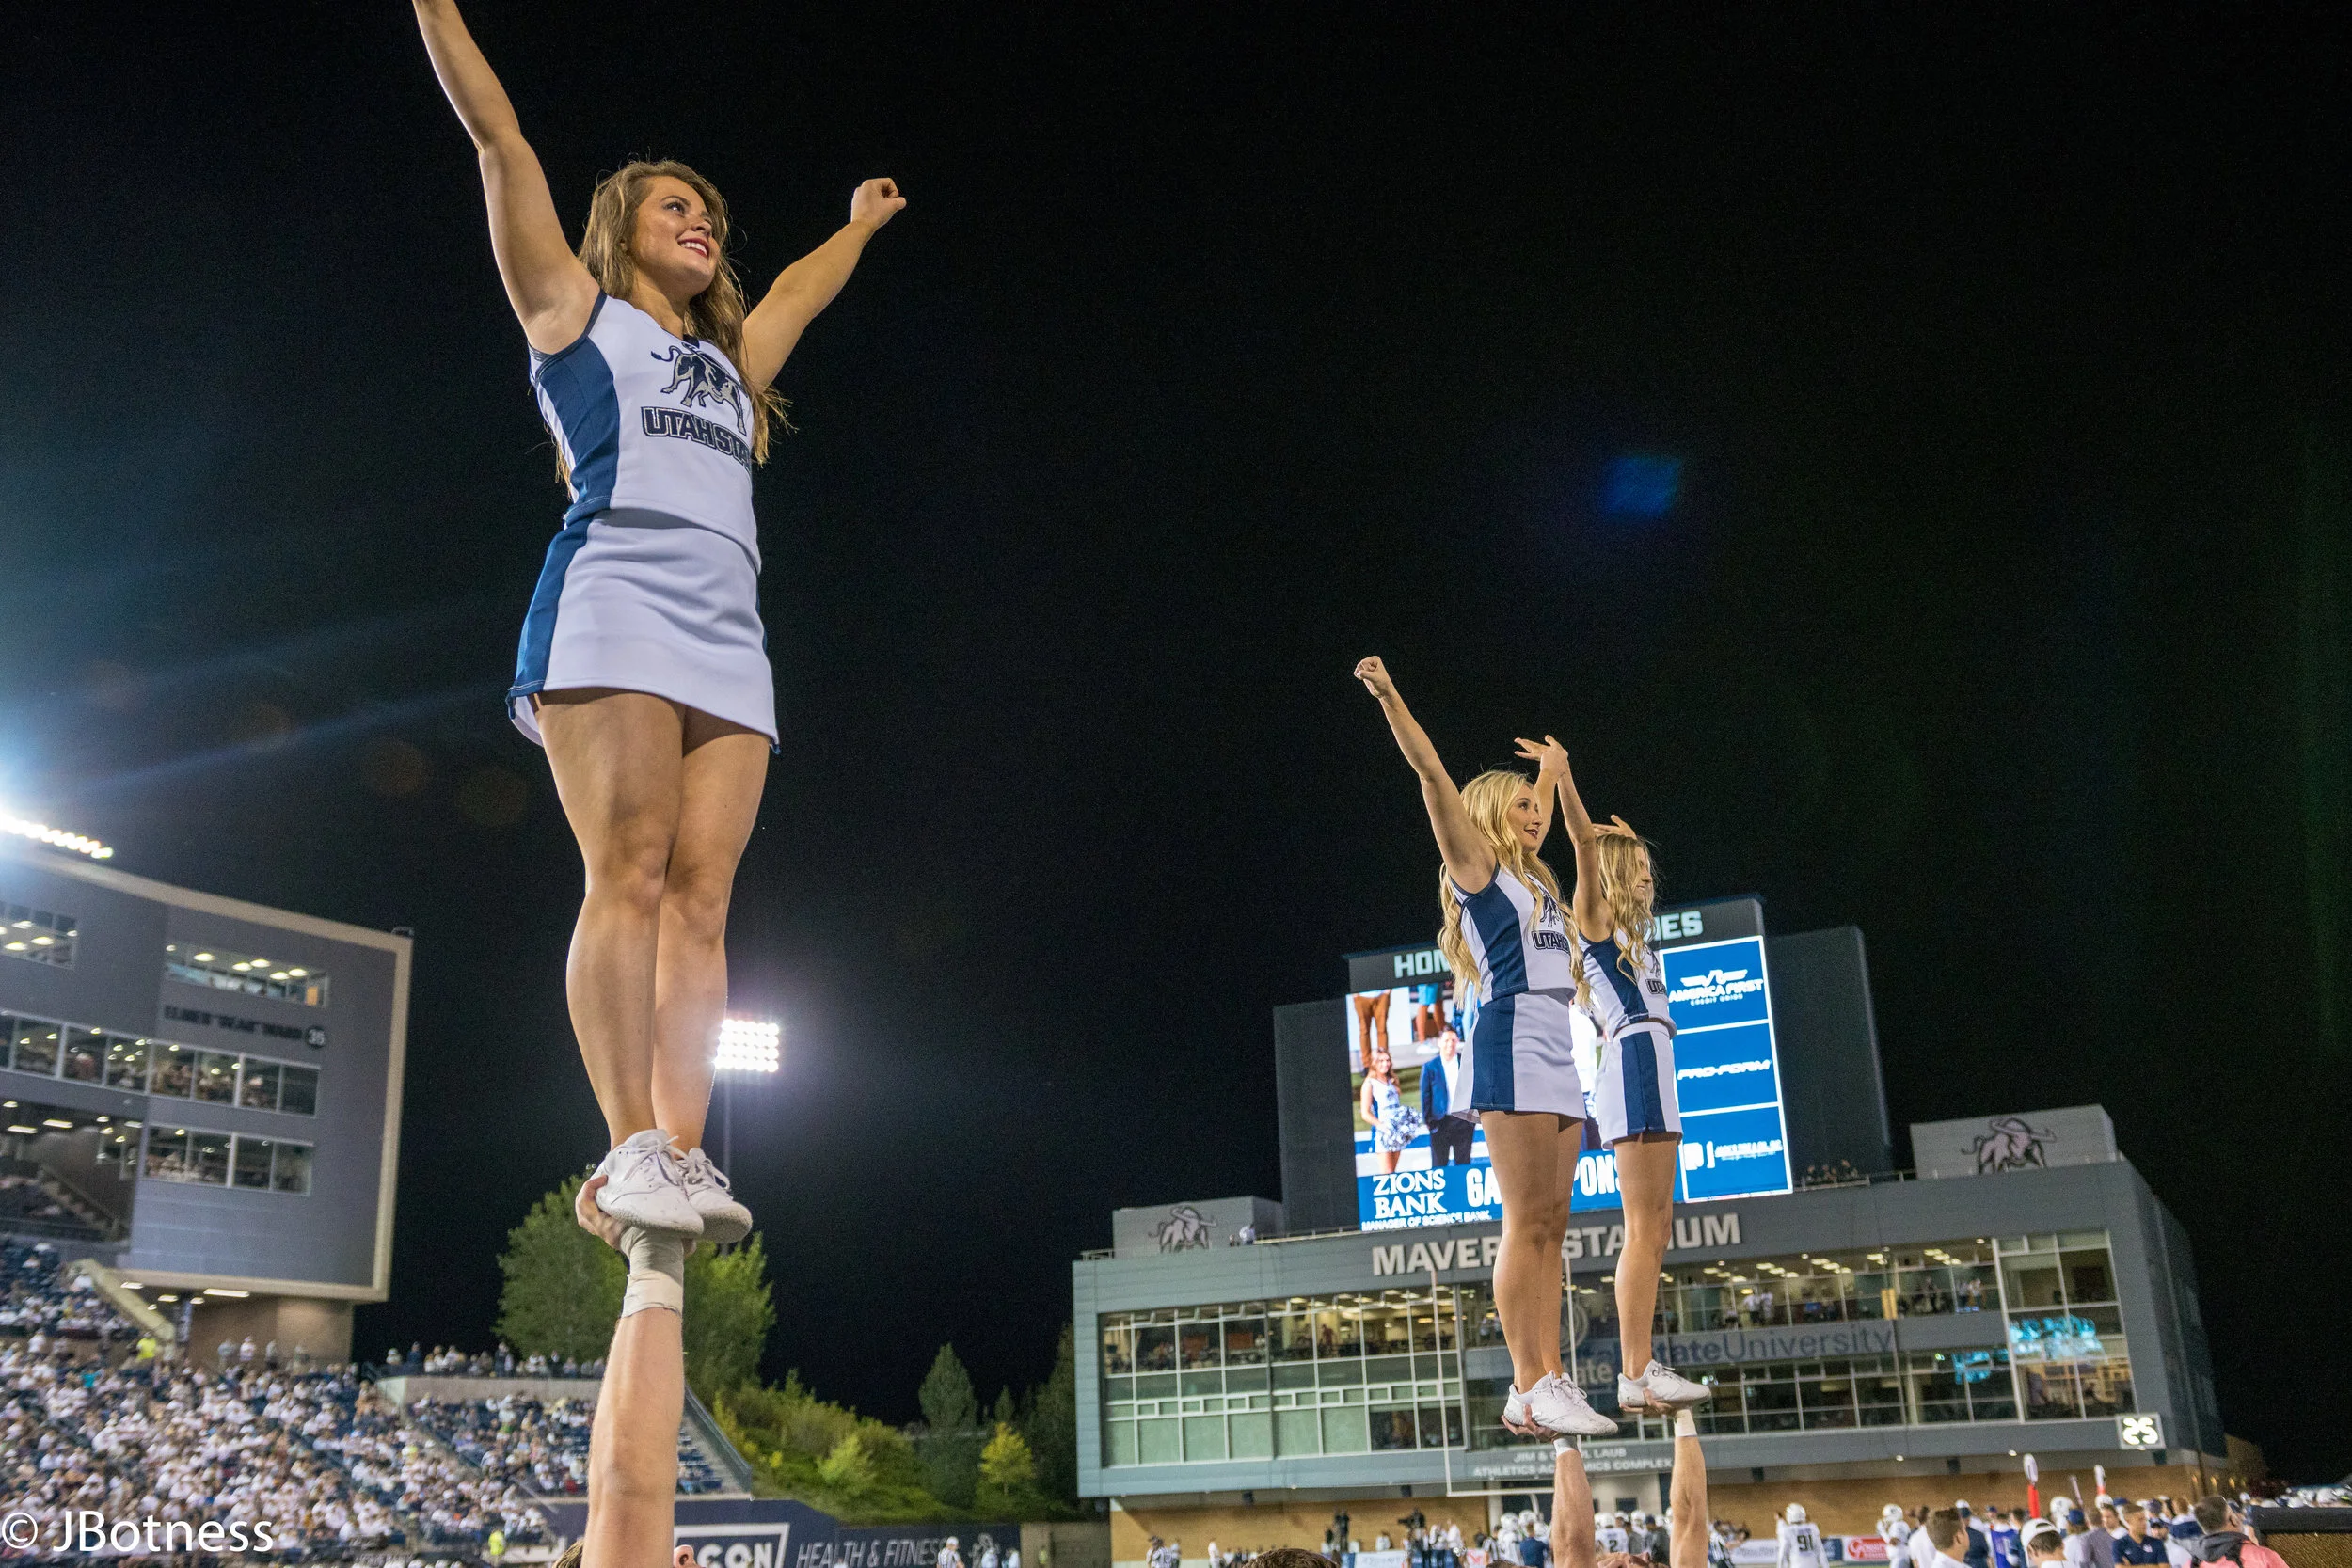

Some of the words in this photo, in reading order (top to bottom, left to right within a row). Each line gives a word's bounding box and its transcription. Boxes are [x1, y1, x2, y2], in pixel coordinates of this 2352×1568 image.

[641, 406, 717, 450] UTAH
[1668, 983, 1725, 1004] AMERICA
[1725, 978, 1764, 995] FIRST
[1677, 1059, 1772, 1080] PRO-FORM
[1373, 1169, 1447, 1196] ZIONS
[1374, 1192, 1448, 1219] BANK
[1513, 1451, 1535, 1464] JIM
[1613, 1458, 1673, 1470] COMPLEX
[697, 1543, 774, 1568] CON
[796, 1541, 866, 1568] HEALTH
[866, 1539, 881, 1567] &
[1609, 1540, 1618, 1553] 2
[1797, 1535, 1814, 1552] 91
